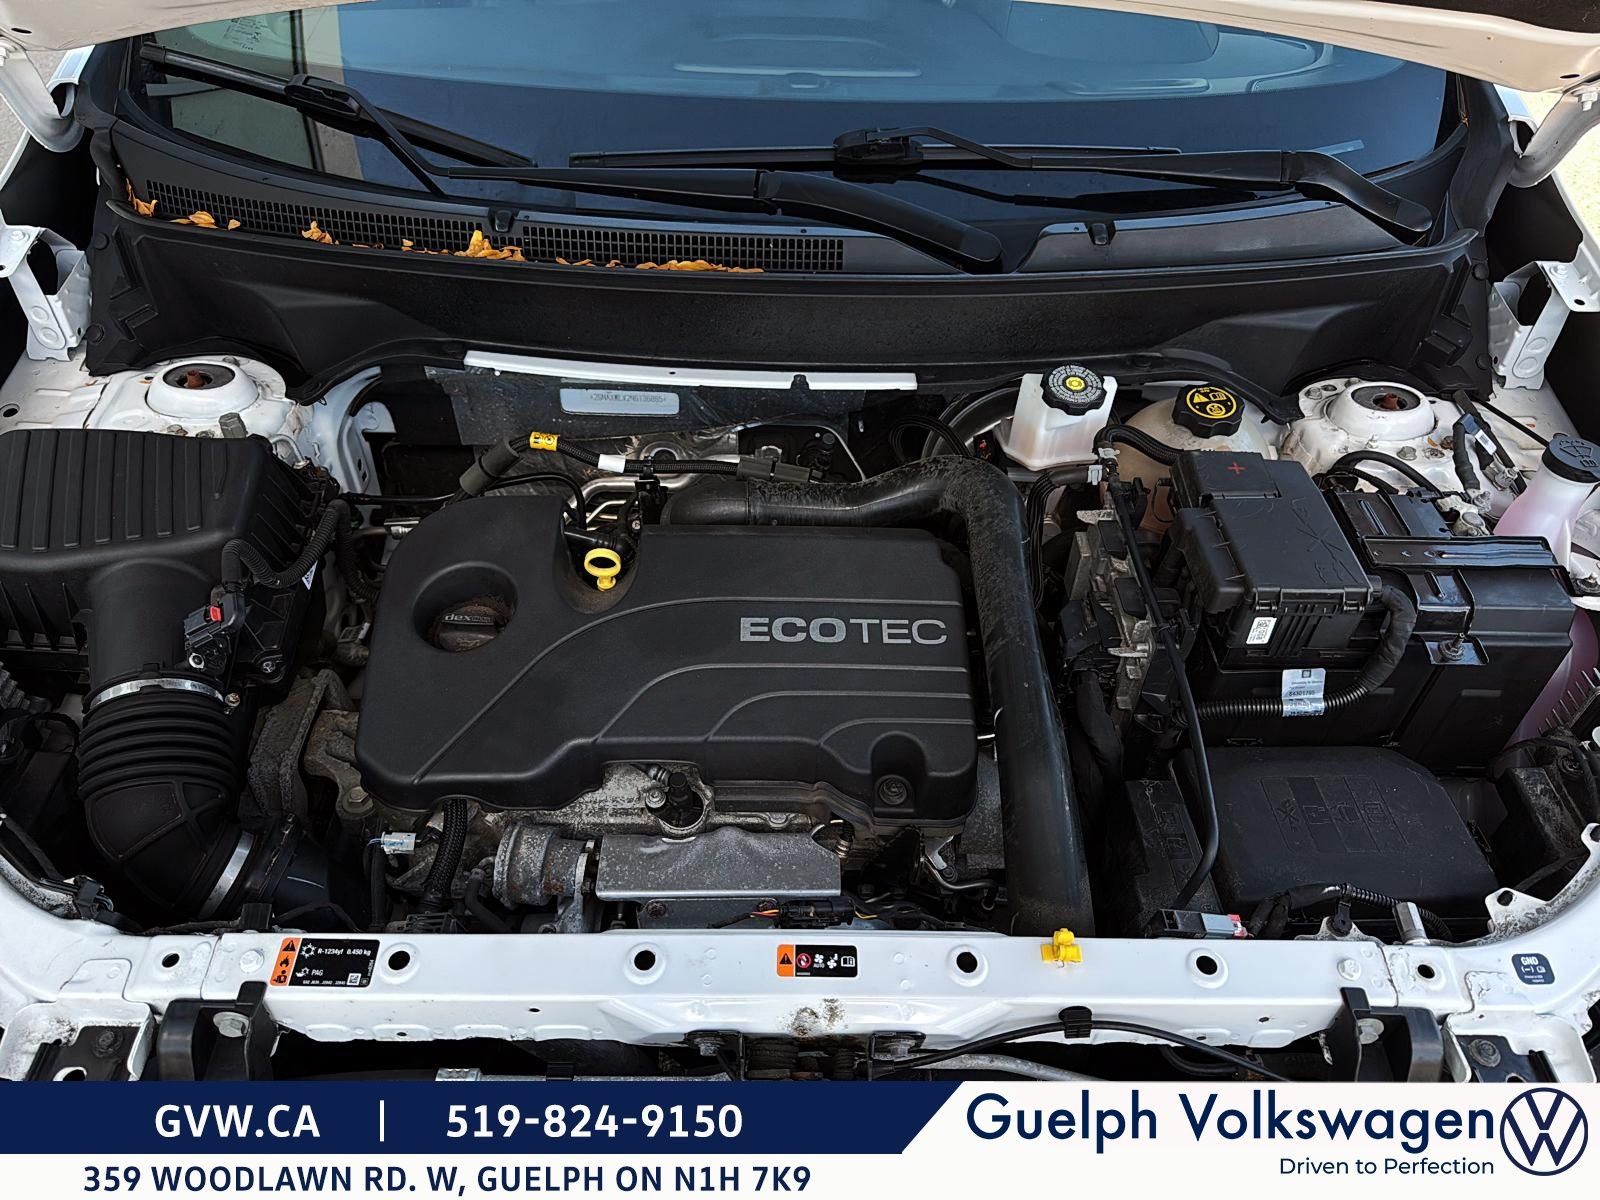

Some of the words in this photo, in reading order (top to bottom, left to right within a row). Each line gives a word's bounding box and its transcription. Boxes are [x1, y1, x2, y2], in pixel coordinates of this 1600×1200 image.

[739, 616, 948, 645] ECOTEC
[317, 948, 344, 956] R-1234yf
[1520, 956, 1539, 965] GND
